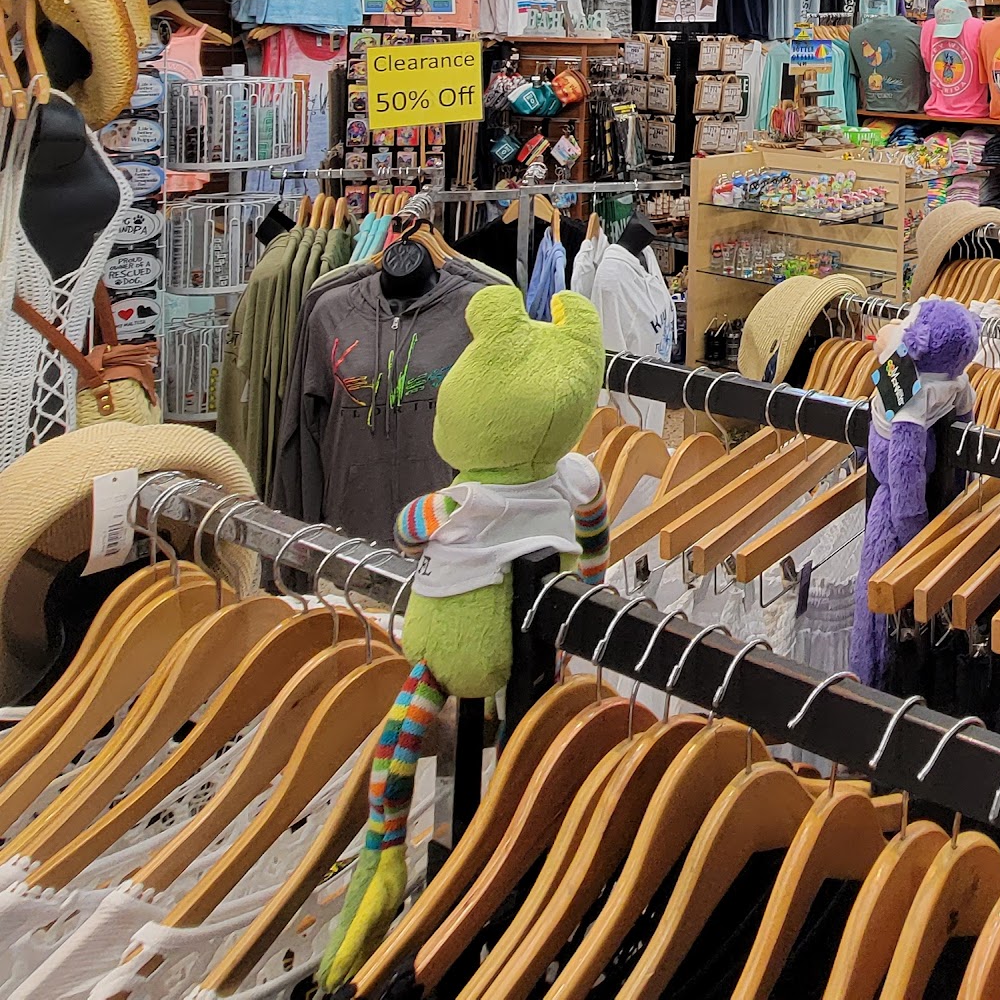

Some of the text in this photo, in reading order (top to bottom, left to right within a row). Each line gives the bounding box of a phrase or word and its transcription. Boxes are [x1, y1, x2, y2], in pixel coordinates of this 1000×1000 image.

[374, 54, 474, 72] Clearance
[376, 85, 476, 112] 50% Off
[108, 268, 151, 278] RESCUED
